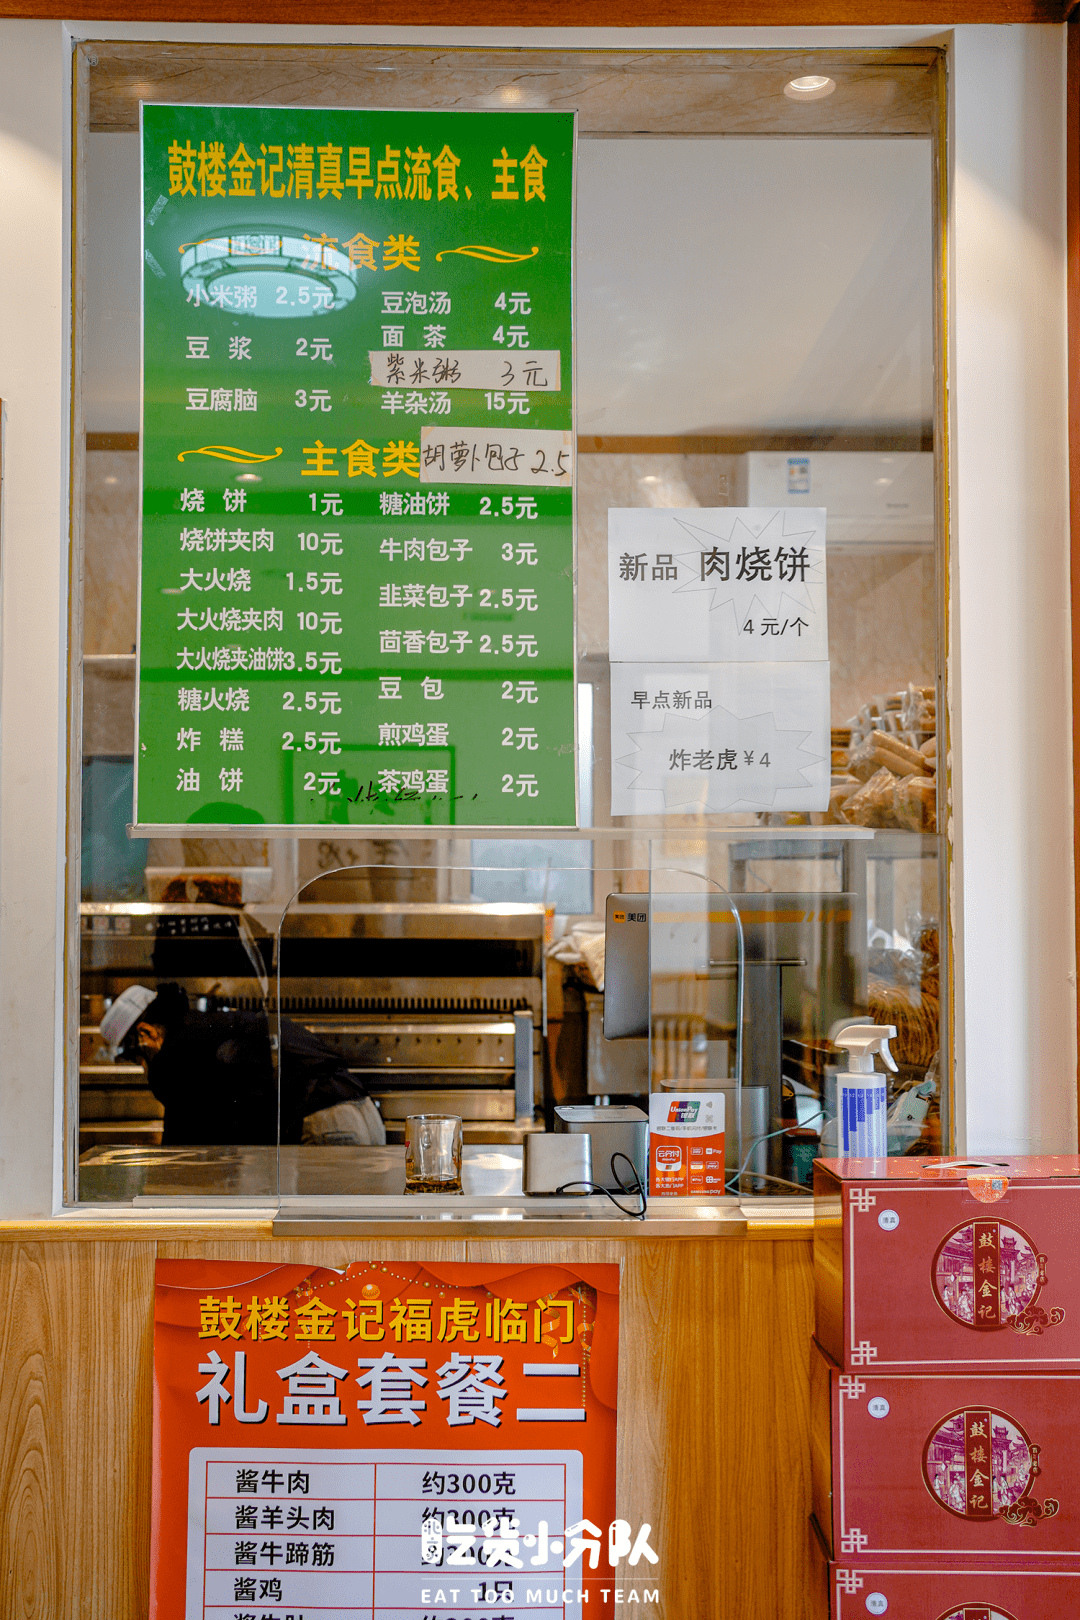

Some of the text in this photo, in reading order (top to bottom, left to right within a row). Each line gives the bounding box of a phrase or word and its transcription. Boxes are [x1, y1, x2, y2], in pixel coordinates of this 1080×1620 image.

[301, 232, 420, 272] 流食类
[186, 285, 335, 309] 小米粥 2.5元
[381, 291, 532, 315] 豆泡汤 4元
[295, 337, 333, 361] 2元
[492, 325, 530, 348] 4元
[387, 353, 461, 384] 紫米粥
[185, 387, 333, 412] 豆腐脑 3元
[380, 391, 531, 415] 羊杂汤 15元
[301, 440, 420, 478] 主食类
[530, 450, 570, 477] 2.5
[308, 492, 344, 516] 1元
[379, 492, 538, 520] 糖油饼 2.5元
[180, 528, 344, 556] 烧饼夹肉 10元
[379, 538, 539, 566] 牛肉包子 3元
[618, 545, 810, 582] 新品 肉烧饼
[180, 567, 344, 595] 大火烧 1.5元
[379, 583, 538, 612] 韭菜包子 2.5元
[177, 607, 343, 635] 大火烧夹肉 10元
[379, 629, 538, 658] 茴香包子 2.5元
[177, 687, 342, 715] 糖火烧 2.5元
[501, 680, 539, 704] 2元
[631, 690, 712, 710] 早点新品
[281, 730, 342, 755] 2.5元
[378, 722, 539, 751] 煎鸡蛋 2元
[303, 771, 342, 796] 2元
[377, 769, 450, 794] 茶鸡蛋
[501, 773, 539, 798] 2元
[627, 912, 647, 923] 美团
[978, 1232, 998, 1320] 鼓楼金记
[198, 1295, 576, 1344] 鼓楼金记福虎临门
[195, 1350, 587, 1427] 礼盒套餐二
[969, 1421, 990, 1510] 鼓楼金记
[235, 1469, 516, 1496] 酱牛肉 约300克
[235, 1505, 335, 1531] 酱羊头肉
[234, 1541, 335, 1566] 酱牛蹄筋
[234, 1577, 283, 1602] 酱鸡
